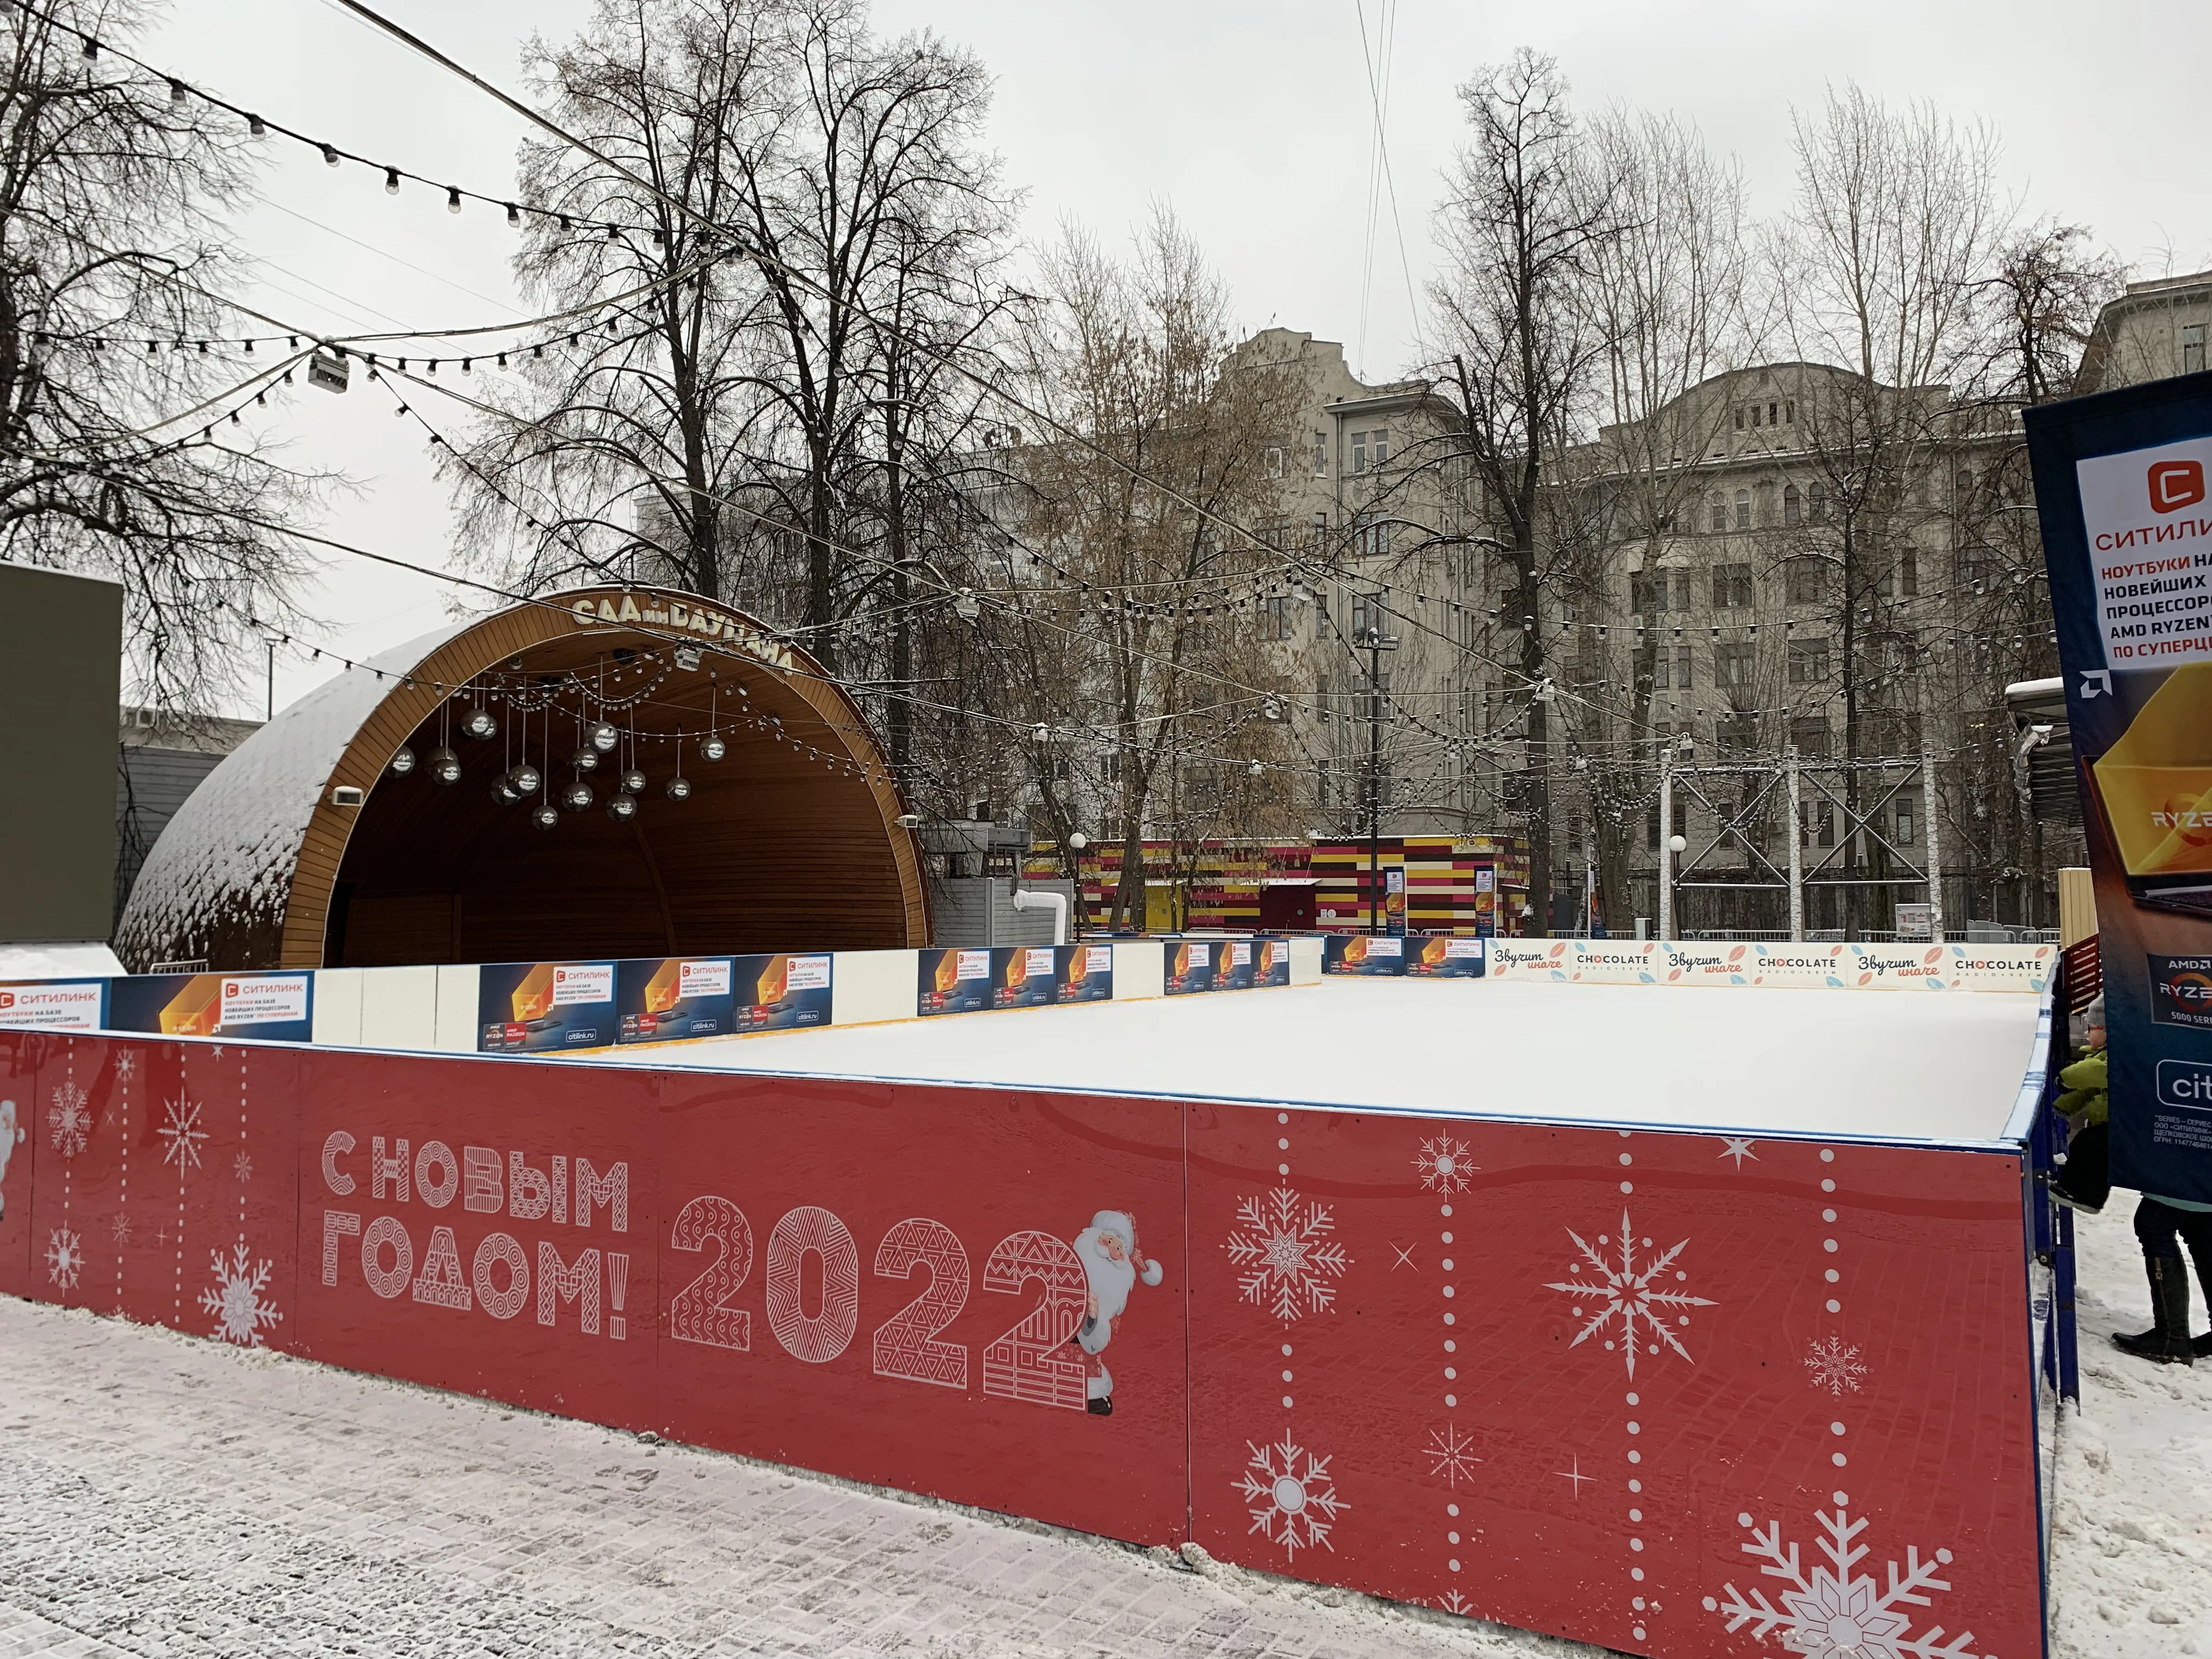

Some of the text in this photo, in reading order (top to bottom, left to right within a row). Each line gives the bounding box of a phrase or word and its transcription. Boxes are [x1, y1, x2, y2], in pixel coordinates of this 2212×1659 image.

[2102, 556, 2191, 579] НОУТБУКИ
[2104, 575, 2207, 600] НОВЕЙШИХ
[572, 595, 641, 625] САД
[2107, 595, 2212, 619] ПРОЦЕССОР
[2111, 615, 2212, 639] AMD RYZEN
[2114, 646, 2133, 658] ПО
[1495, 949, 1544, 968] Звучит
[1577, 955, 1648, 964] CHOCOLATE
[1669, 952, 1722, 972] Звучит
[1758, 958, 1836, 967] CHOCOLATE
[1858, 955, 1917, 975] Звучит
[1955, 960, 2041, 970] CHOCOLATE
[2169, 960, 2199, 969] AMD
[1705, 964, 1742, 973] иначе
[1898, 967, 1940, 977] иначе
[243, 984, 303, 994] СИТИЛИНК
[20, 992, 96, 1005] СИТИЛИНК
[2171, 1012, 2192, 1022] 5000
[692, 1021, 715, 1030] citilink.ru
[321, 1131, 628, 1232] С НОВЫМ
[322, 1209, 629, 1341] ГОДОМ!
[672, 1196, 1088, 1411] 2022
